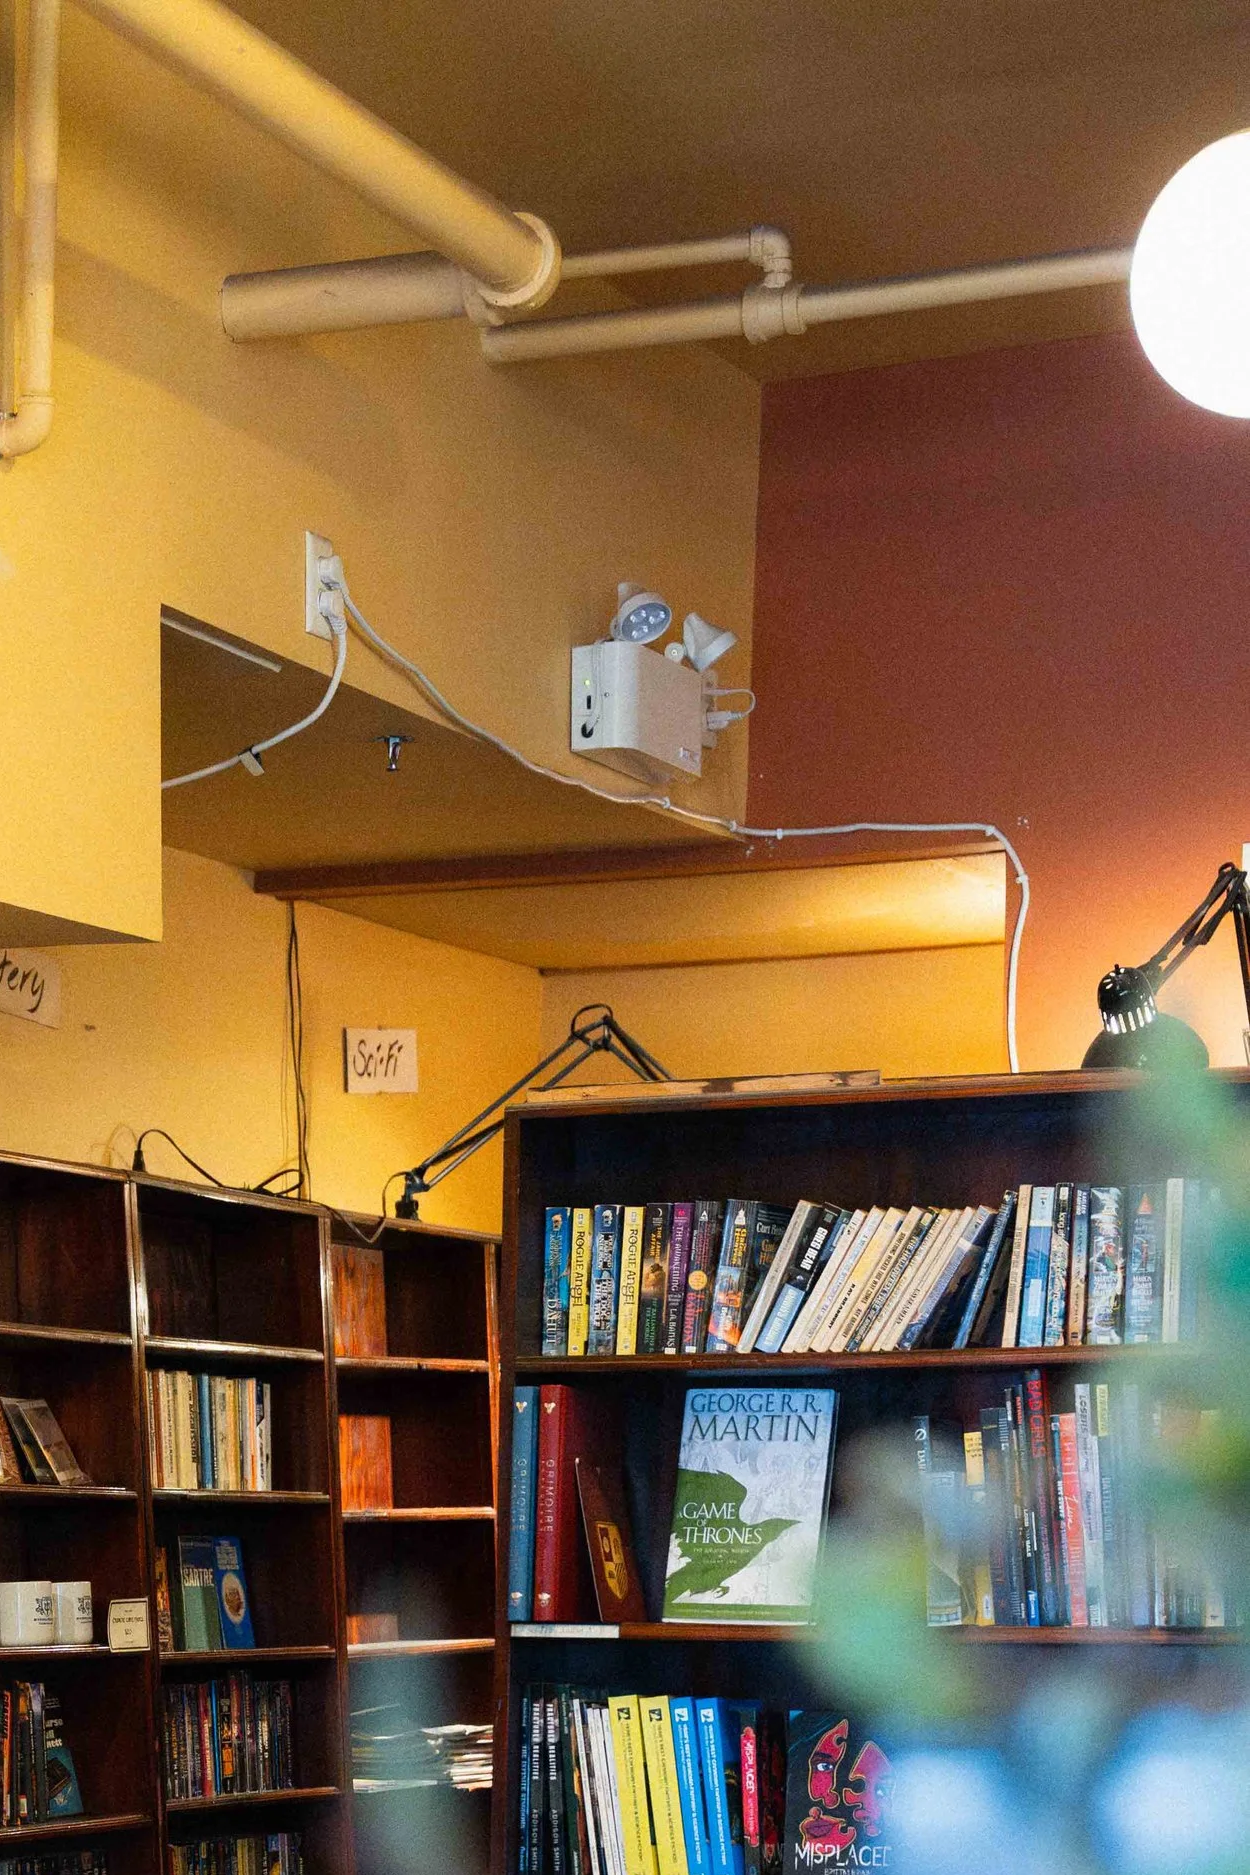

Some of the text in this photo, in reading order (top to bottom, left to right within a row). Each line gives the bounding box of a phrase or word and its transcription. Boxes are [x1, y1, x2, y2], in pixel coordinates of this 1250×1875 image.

[576, 1231, 585, 1270] ROGUE
[628, 1228, 638, 1269] ROGUE
[671, 1226, 684, 1292] THE AWAKENING
[799, 1226, 828, 1271] GREG BEAR
[861, 1232, 906, 1304] SOMETHING WICKED COMES
[546, 1299, 557, 1346] DAHUT
[828, 1283, 856, 1329] RAY BRADBURY
[667, 1322, 676, 1348] BANKS
[690, 1393, 822, 1414] GEORGE R. R.
[1028, 1379, 1044, 1458] BAD GIRLS
[688, 1415, 819, 1442] MARTIN
[682, 1502, 739, 1520] GAME
[682, 1526, 763, 1545] THRONES
[183, 1567, 215, 1588] SARTRE
[744, 1740, 755, 1794] MISPLACED
